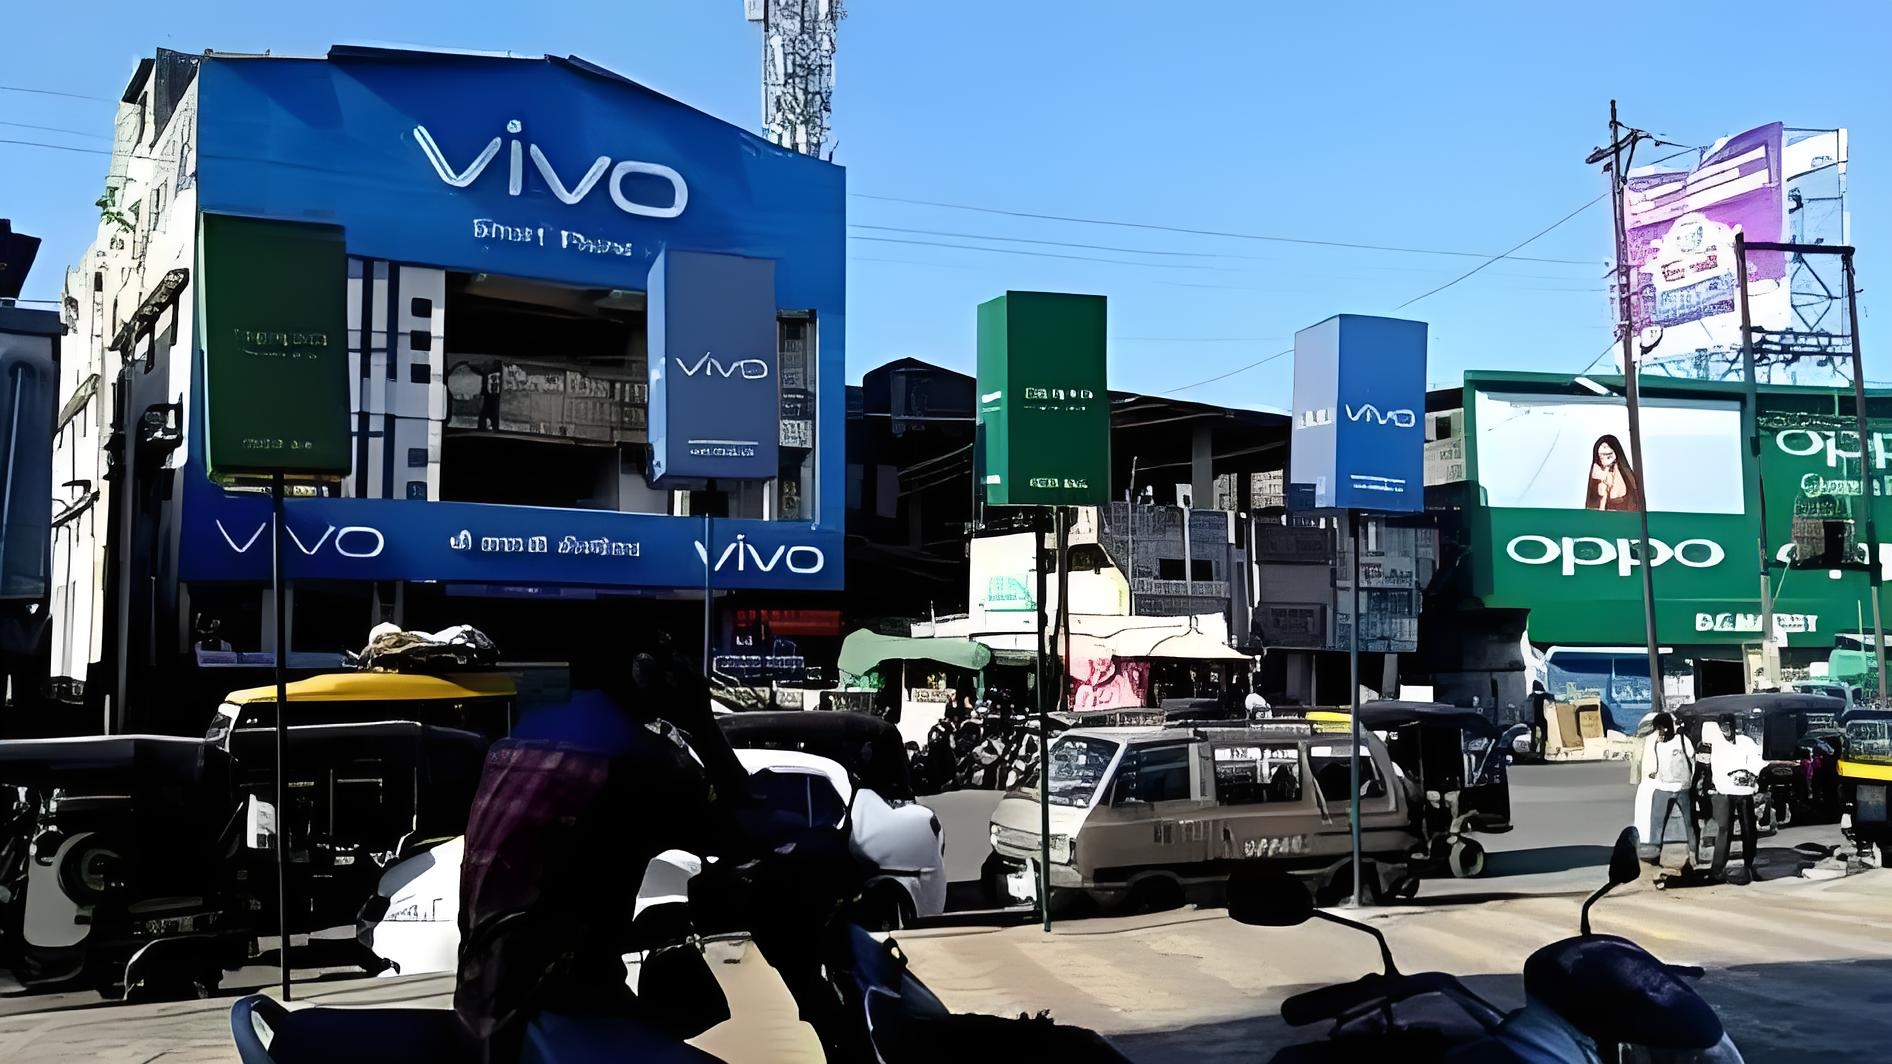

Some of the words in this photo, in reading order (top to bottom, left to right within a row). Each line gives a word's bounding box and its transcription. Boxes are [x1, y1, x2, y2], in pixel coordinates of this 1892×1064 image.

[413, 119, 689, 218] vivo
[676, 351, 769, 379] vivo
[694, 534, 825, 574] vivo
[1506, 534, 1725, 577] oppo
